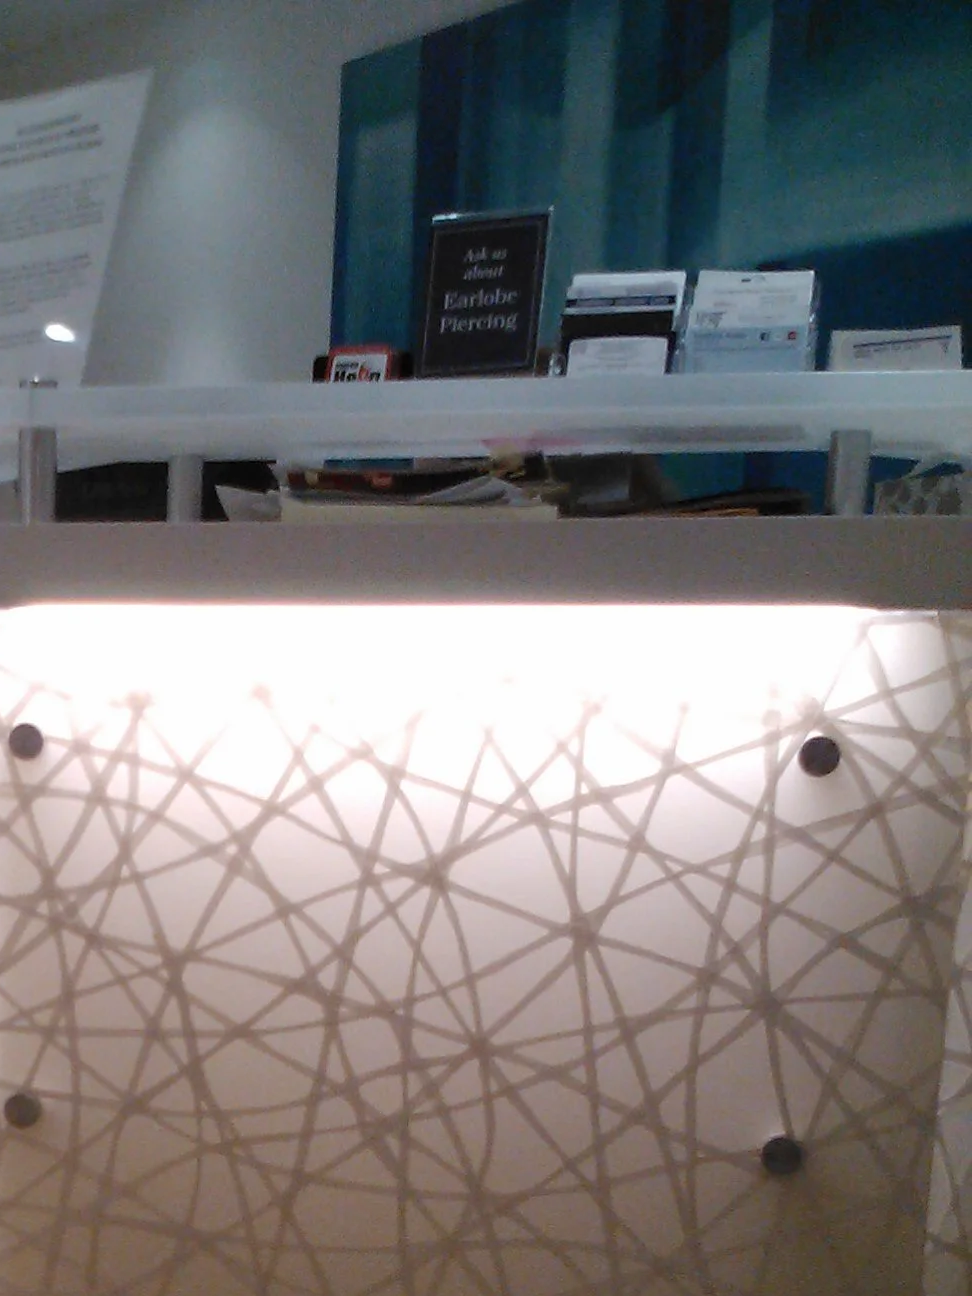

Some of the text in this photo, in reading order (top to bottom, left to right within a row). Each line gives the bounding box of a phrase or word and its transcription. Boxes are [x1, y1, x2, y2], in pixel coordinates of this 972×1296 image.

[464, 247, 488, 262] Ask
[463, 265, 504, 281] about
[444, 287, 519, 310] Earlobe
[440, 313, 519, 333] Piercing
